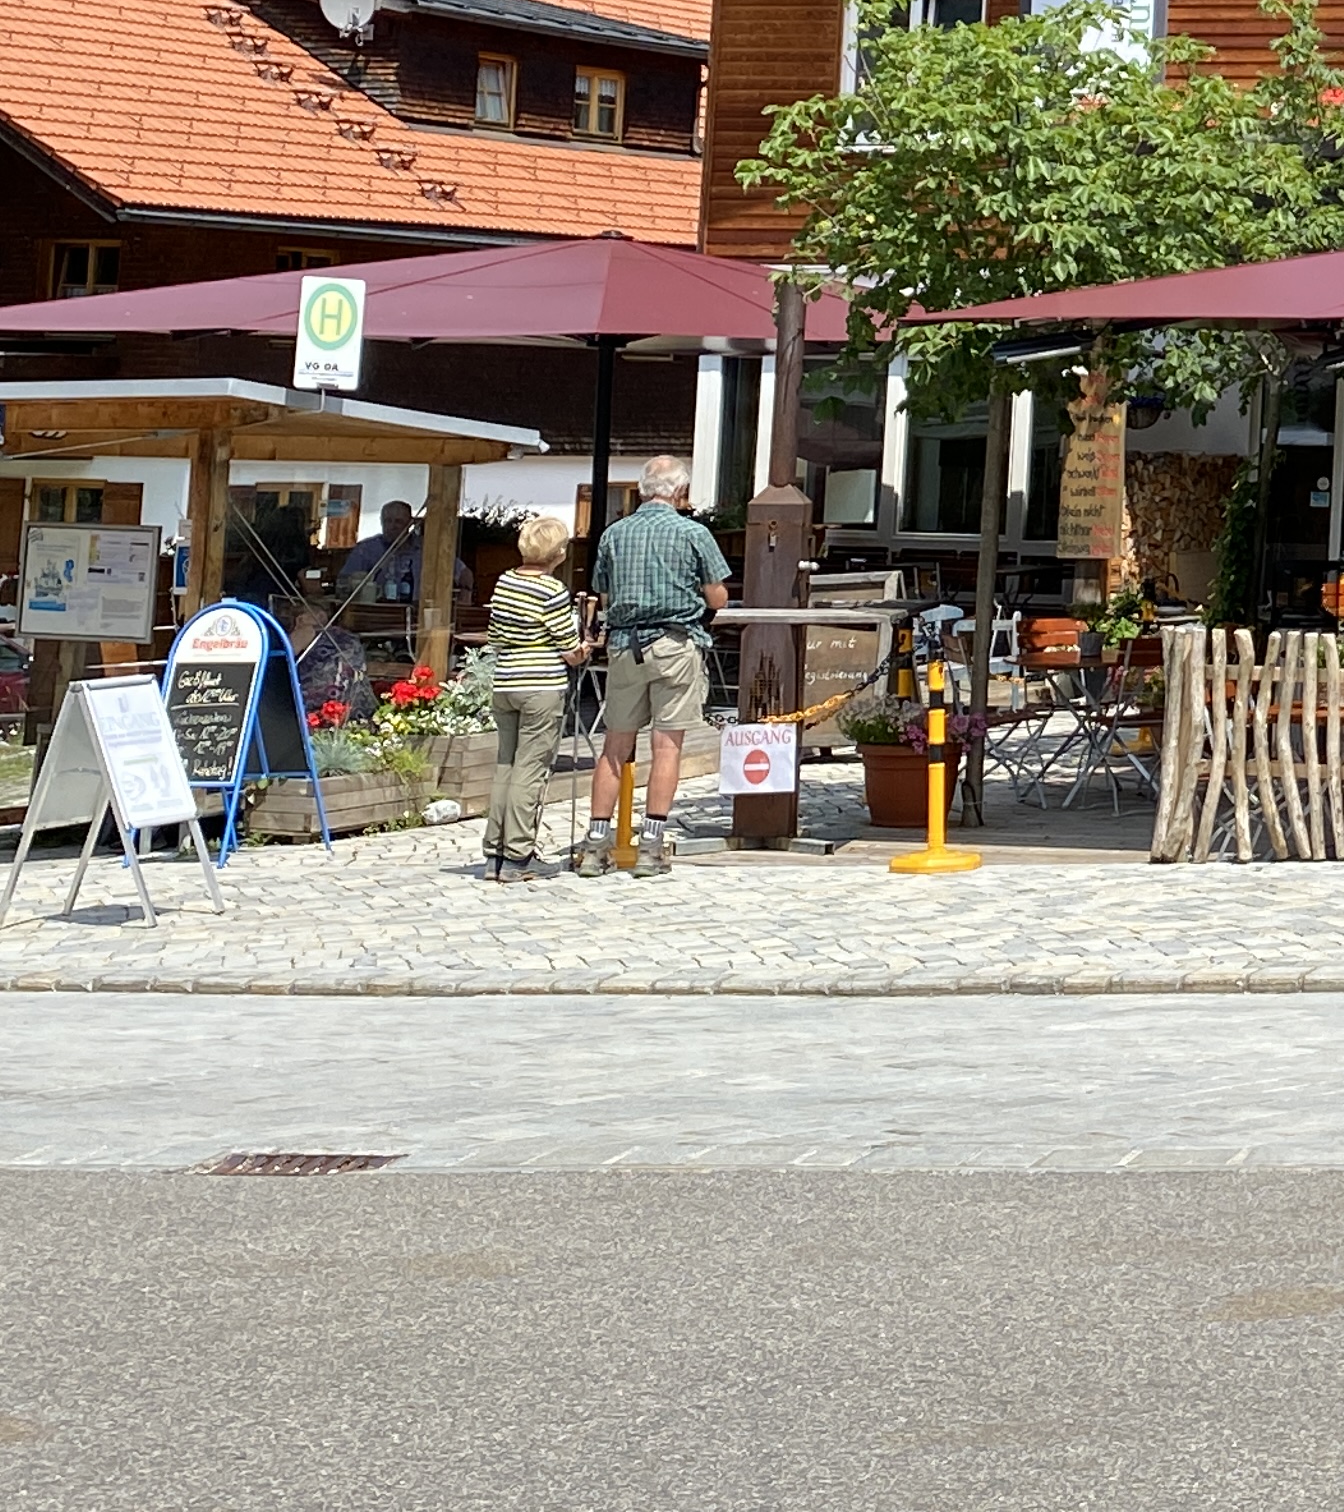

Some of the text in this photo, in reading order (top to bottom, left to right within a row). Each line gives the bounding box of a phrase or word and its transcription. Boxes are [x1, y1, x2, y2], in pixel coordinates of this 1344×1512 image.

[319, 297, 343, 336] H
[191, 637, 249, 652] Engelbräu
[724, 729, 792, 747] AUSGANG
